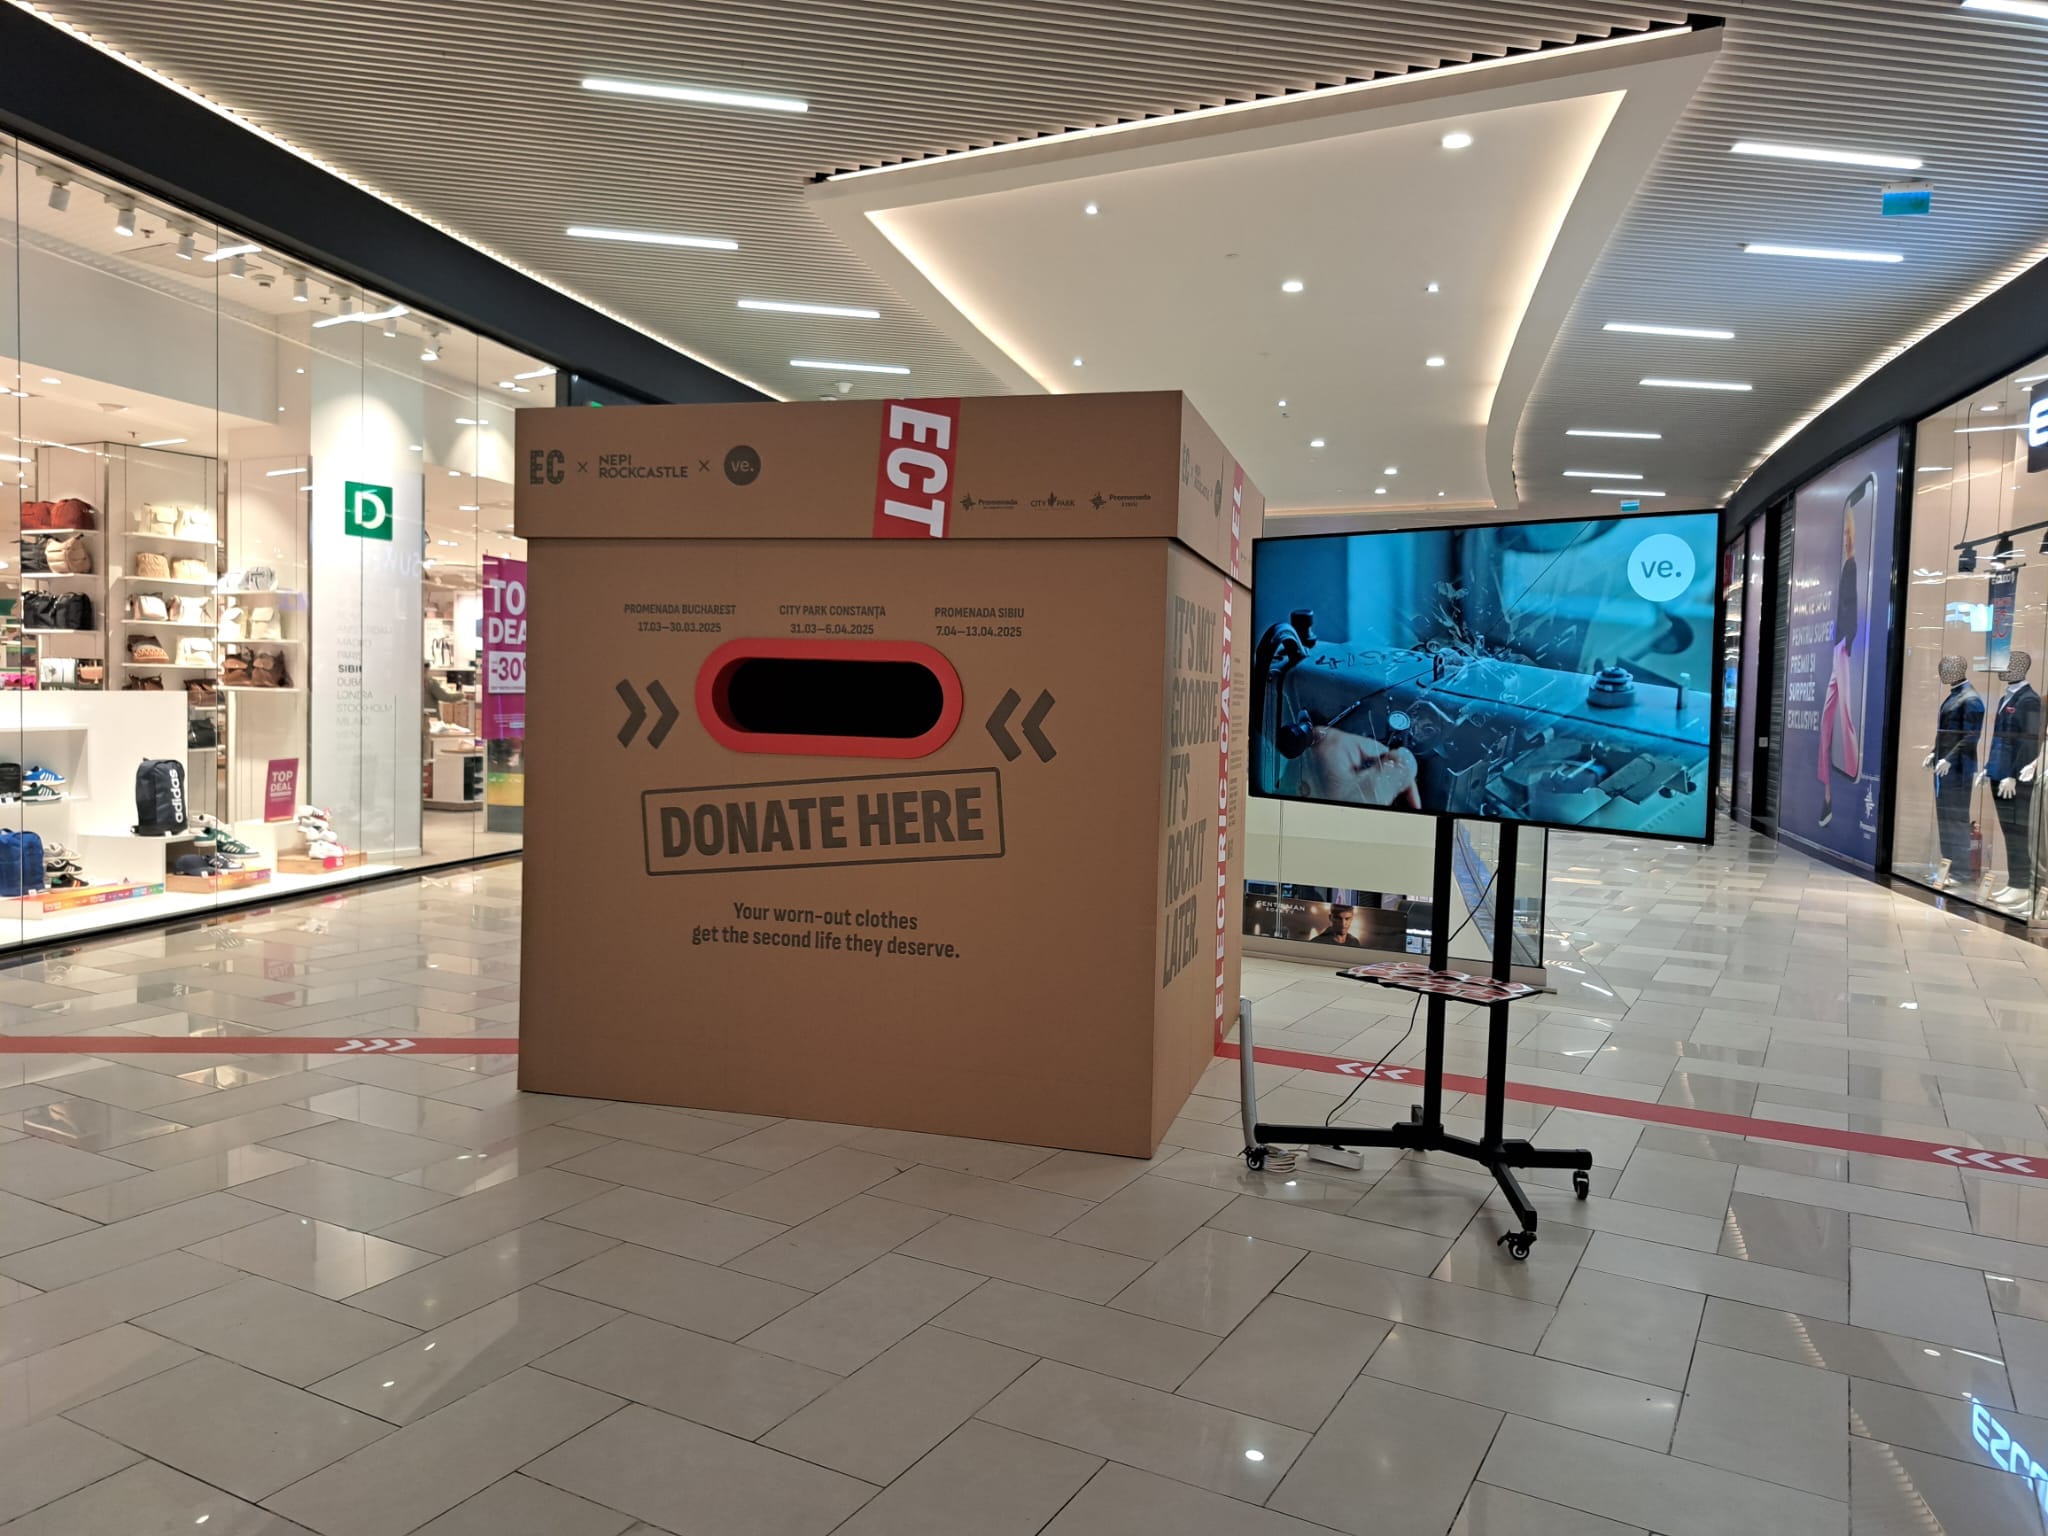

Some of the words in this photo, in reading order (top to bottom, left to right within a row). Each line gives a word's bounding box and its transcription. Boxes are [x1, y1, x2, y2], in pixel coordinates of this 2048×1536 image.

[530, 449, 565, 485] EC
[599, 454, 632, 466] NEPI
[599, 466, 689, 479] ROCKCASTLE
[730, 459, 755, 473] ve.
[883, 404, 952, 538] ECT
[354, 491, 386, 529] D
[1641, 558, 1682, 578] ve.
[488, 577, 526, 616] TO
[624, 604, 681, 614] PROMENADA
[681, 604, 737, 615] BUCHAREST
[779, 605, 801, 616] CITY
[802, 606, 828, 616] PARK
[934, 607, 997, 618] PROMENADA
[998, 607, 1025, 618] SIBIU
[488, 617, 526, 645] DEA
[491, 656, 526, 682] -30
[1171, 677, 1219, 748] GOODBYE.
[270, 782, 293, 792] DEAL
[272, 771, 293, 782] TOP
[169, 769, 185, 824] adidas
[660, 796, 848, 858] DONATE
[857, 787, 985, 847] HERE
[734, 901, 770, 920] Your
[773, 906, 852, 926] worn-out
[855, 910, 918, 930] clothes
[692, 924, 720, 945] get
[722, 926, 750, 944] the
[752, 929, 811, 948] second
[815, 930, 842, 950] life
[845, 935, 883, 958] they
[887, 936, 961, 960] deserve.
[1163, 894, 1199, 989] LATER.
